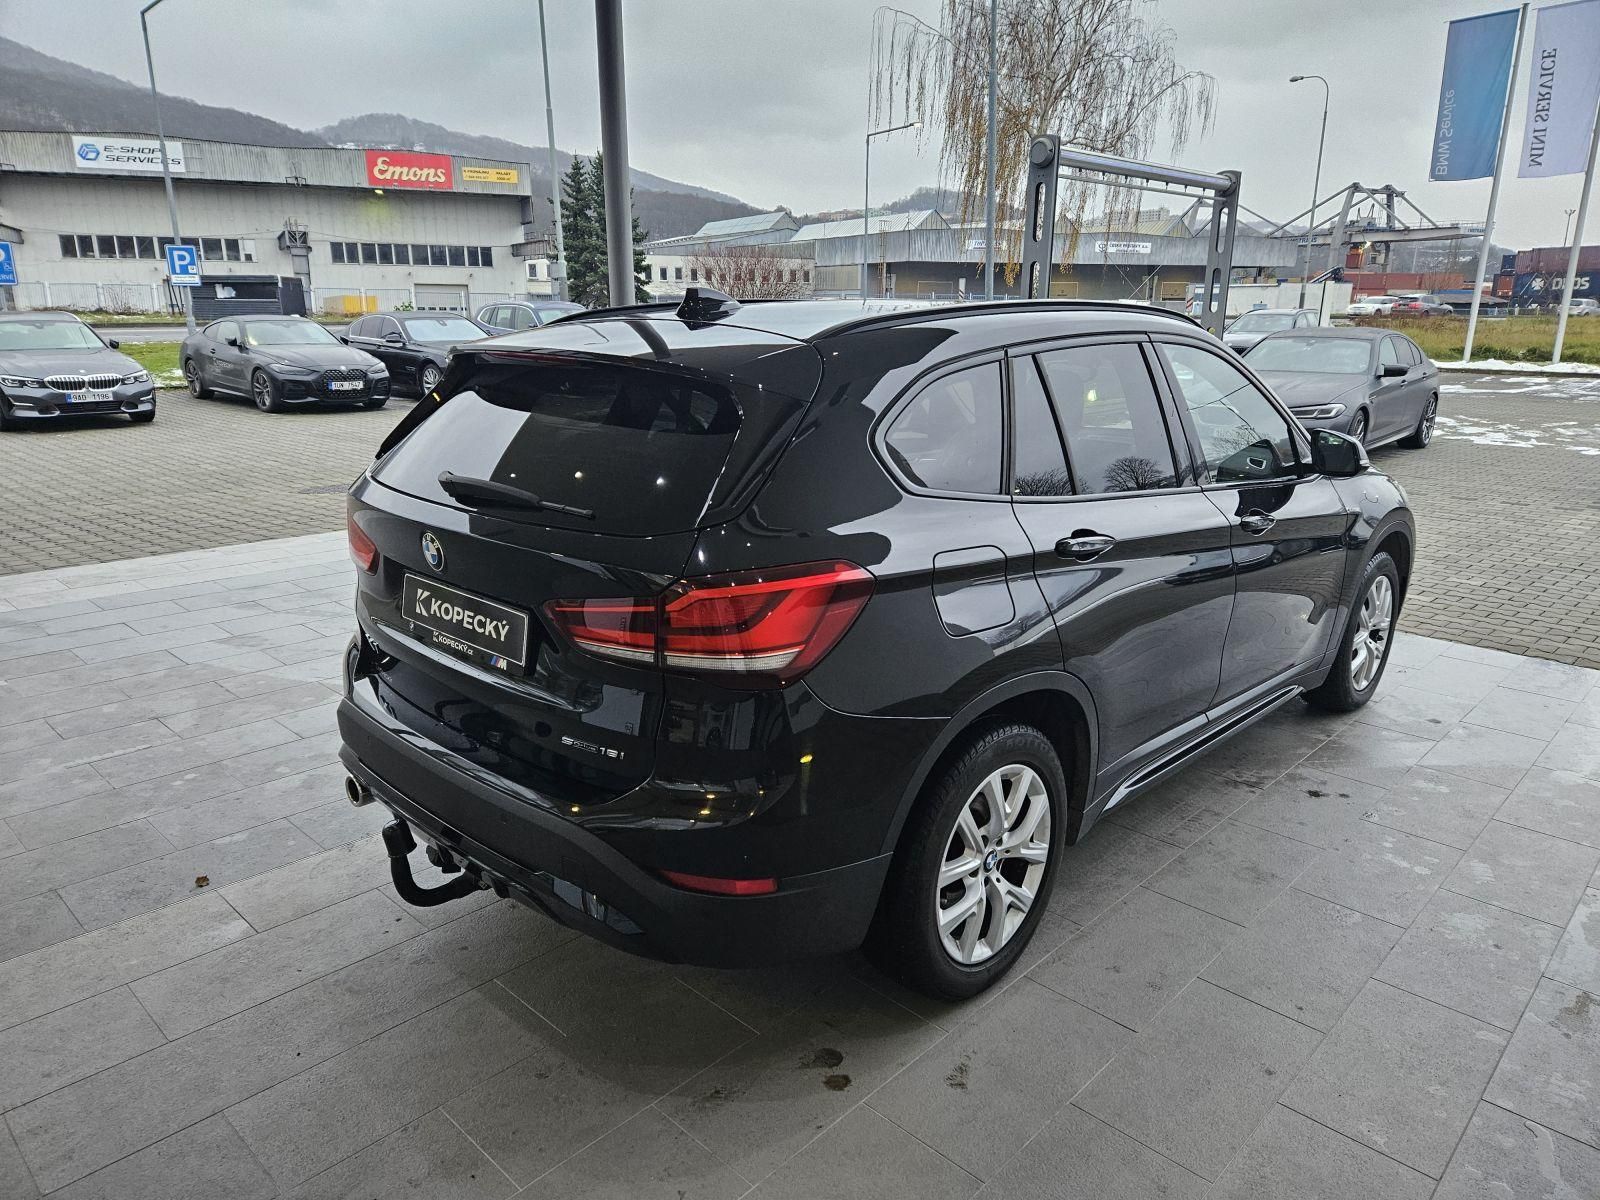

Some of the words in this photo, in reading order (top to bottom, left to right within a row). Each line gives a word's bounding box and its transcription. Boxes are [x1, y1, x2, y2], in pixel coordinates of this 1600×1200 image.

[373, 156, 446, 183] Emons
[172, 250, 191, 274] P
[430, 598, 510, 642] KOPECKÝ
